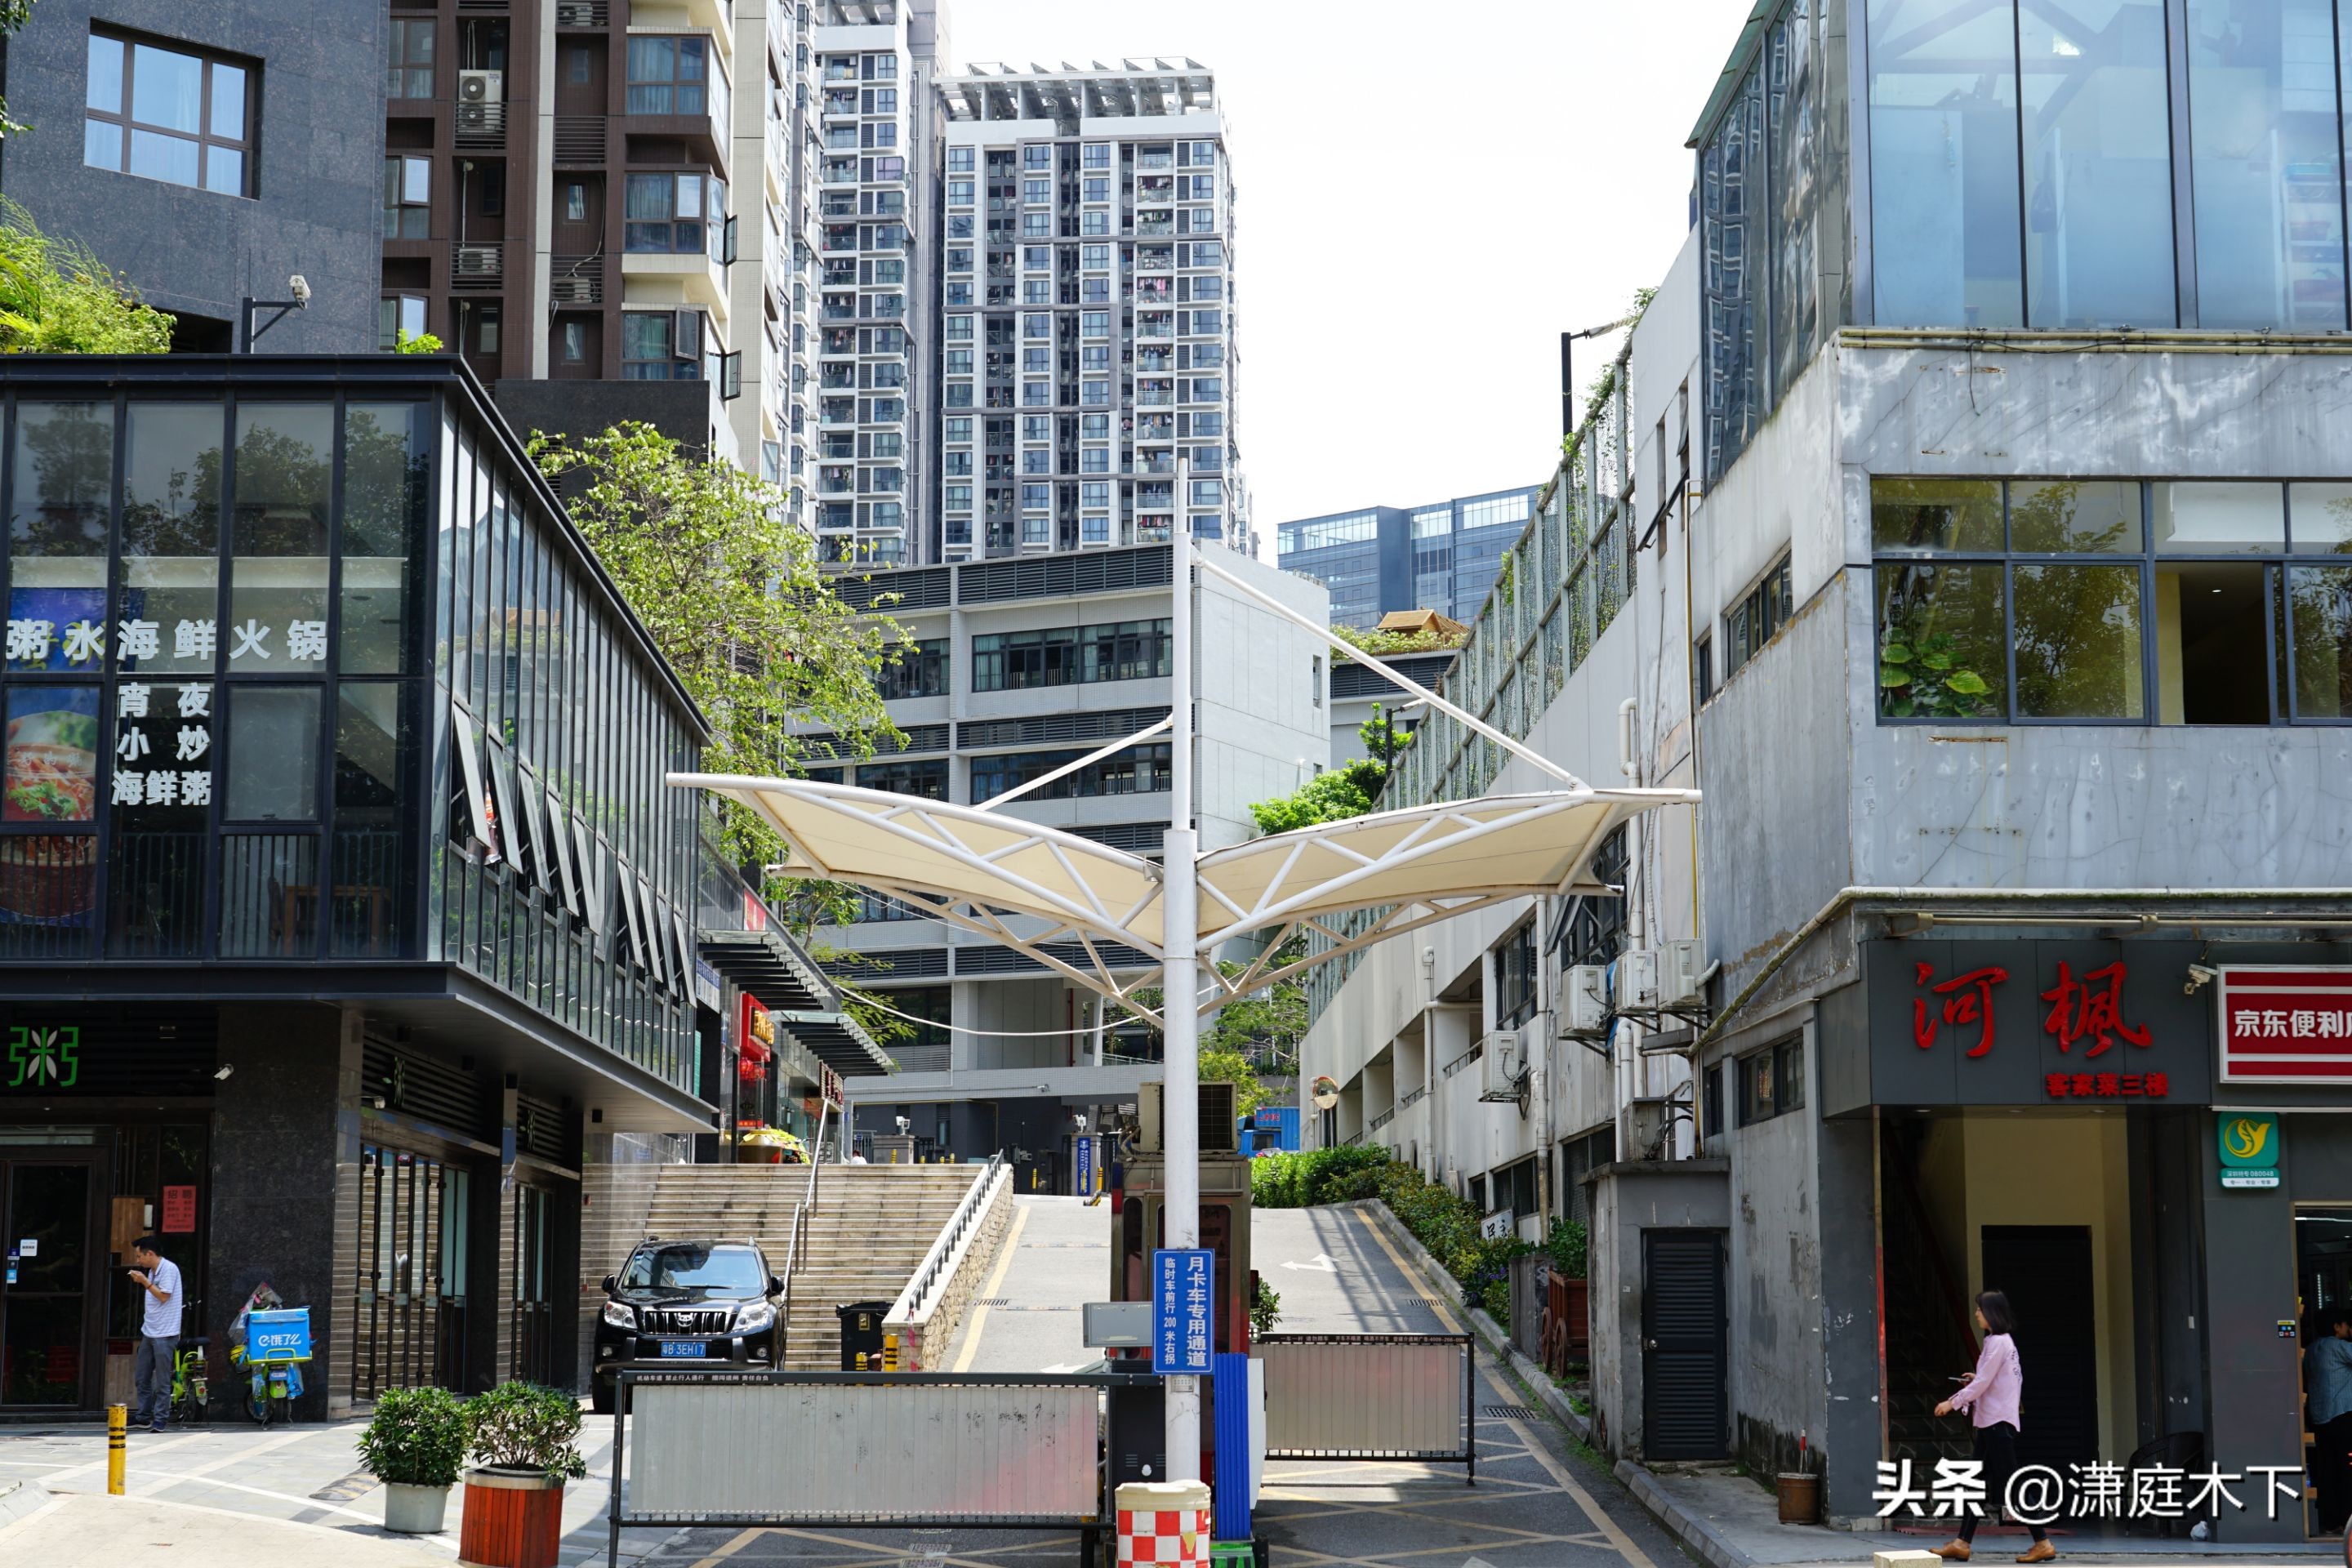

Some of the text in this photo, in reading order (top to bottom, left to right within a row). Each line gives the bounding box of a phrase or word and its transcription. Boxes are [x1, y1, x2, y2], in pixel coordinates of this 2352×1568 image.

[111, 770, 212, 806] 海鲜粥
[1914, 961, 2153, 1057] 河枫
[1187, 1256, 1207, 1367] 月卡车专用通道
